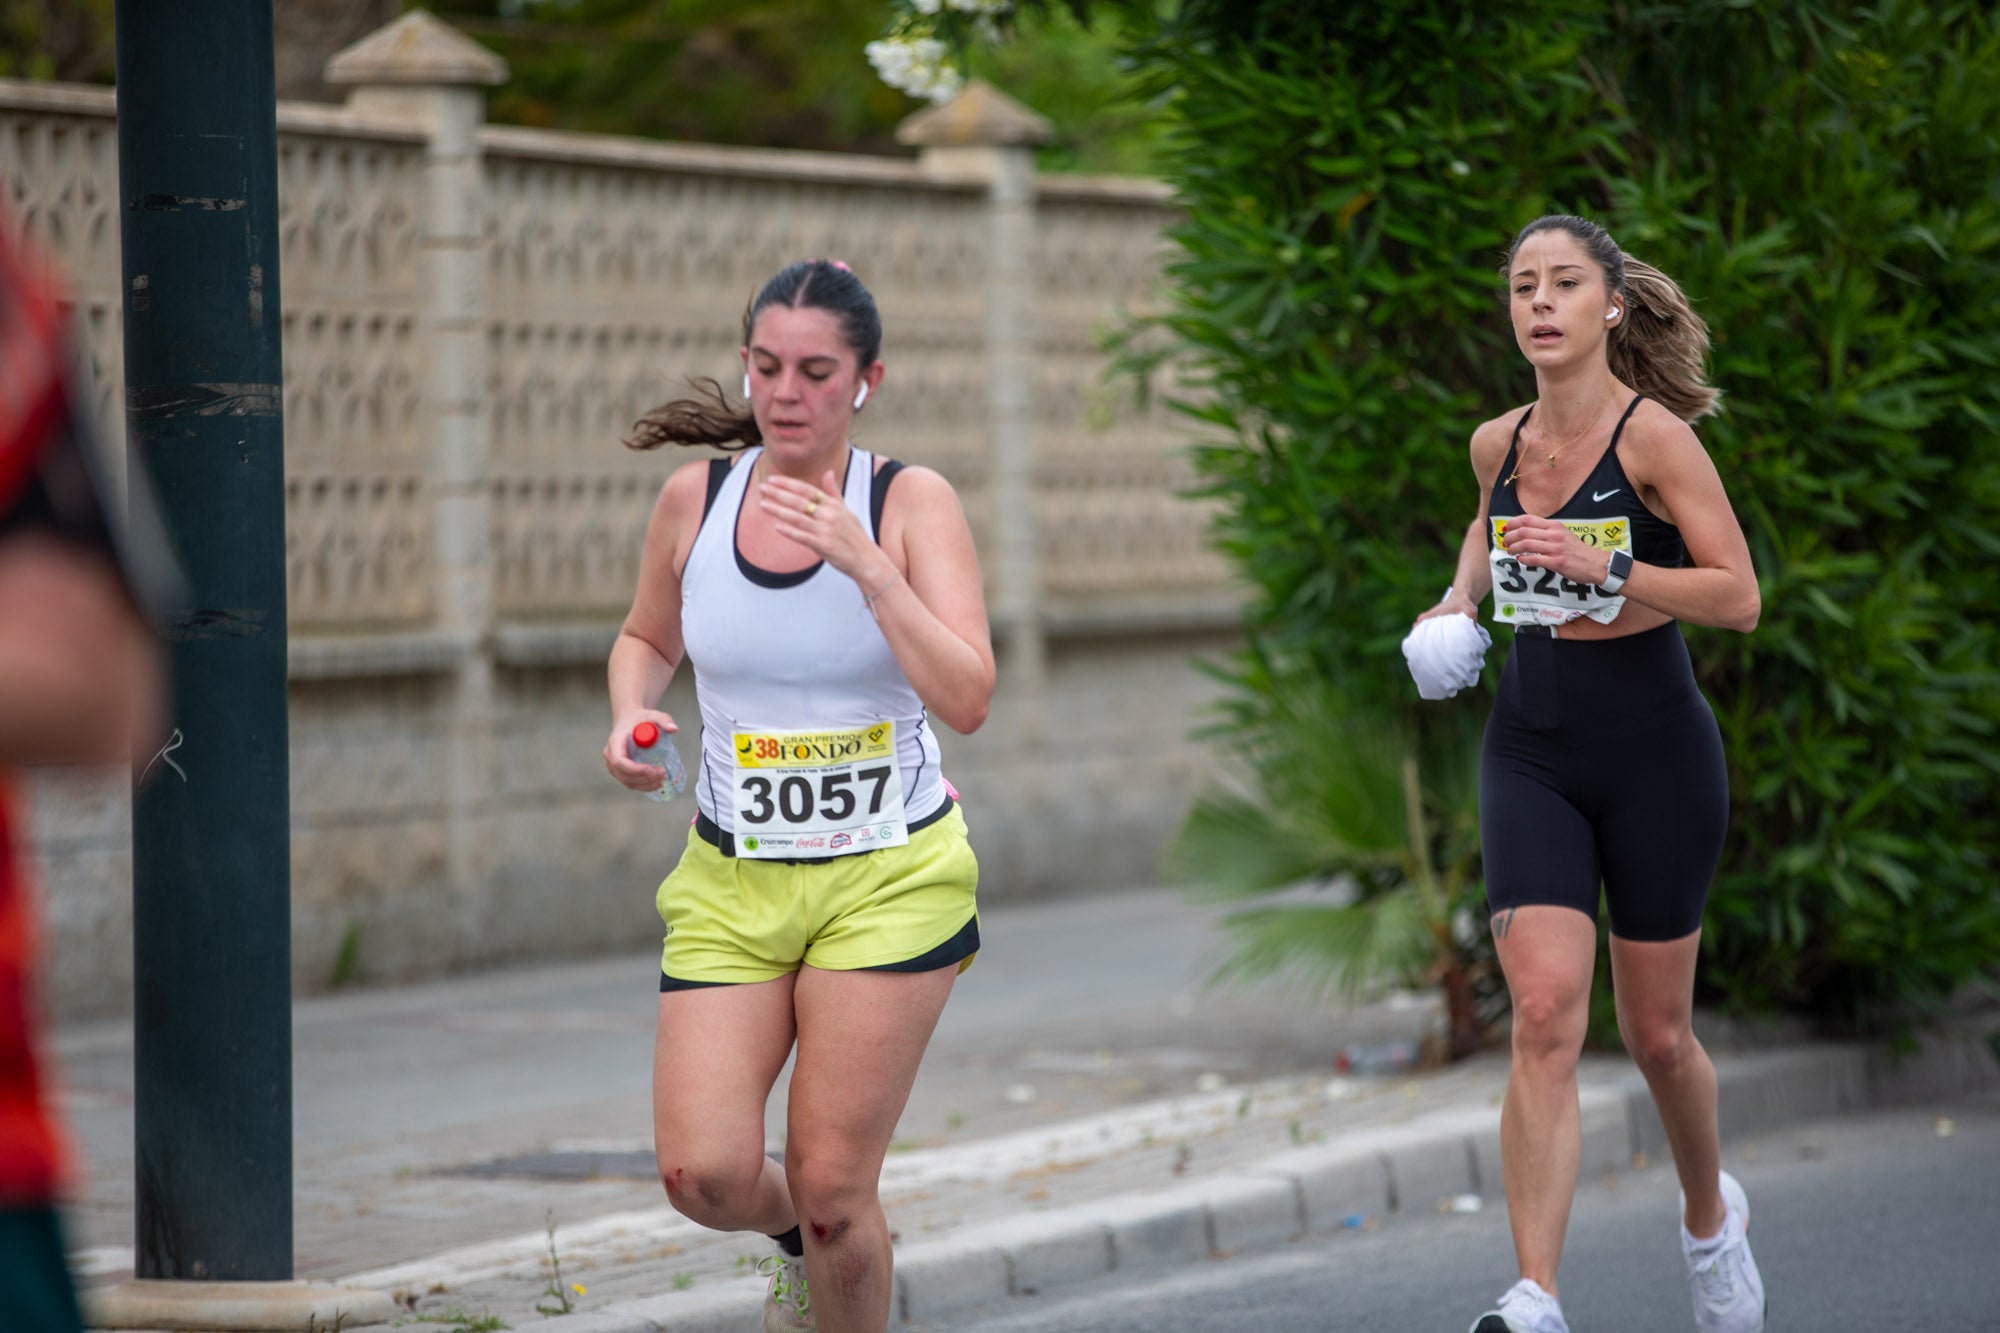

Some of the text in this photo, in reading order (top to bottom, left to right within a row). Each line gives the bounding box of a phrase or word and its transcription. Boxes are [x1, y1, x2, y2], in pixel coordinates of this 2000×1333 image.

[755, 738, 779, 759] 38
[783, 735, 812, 744] GRAN
[815, 733, 856, 743] PREMIO
[780, 740, 861, 760] FONDO
[740, 765, 892, 824] 3057
[760, 837, 794, 847] Cruzcampo
